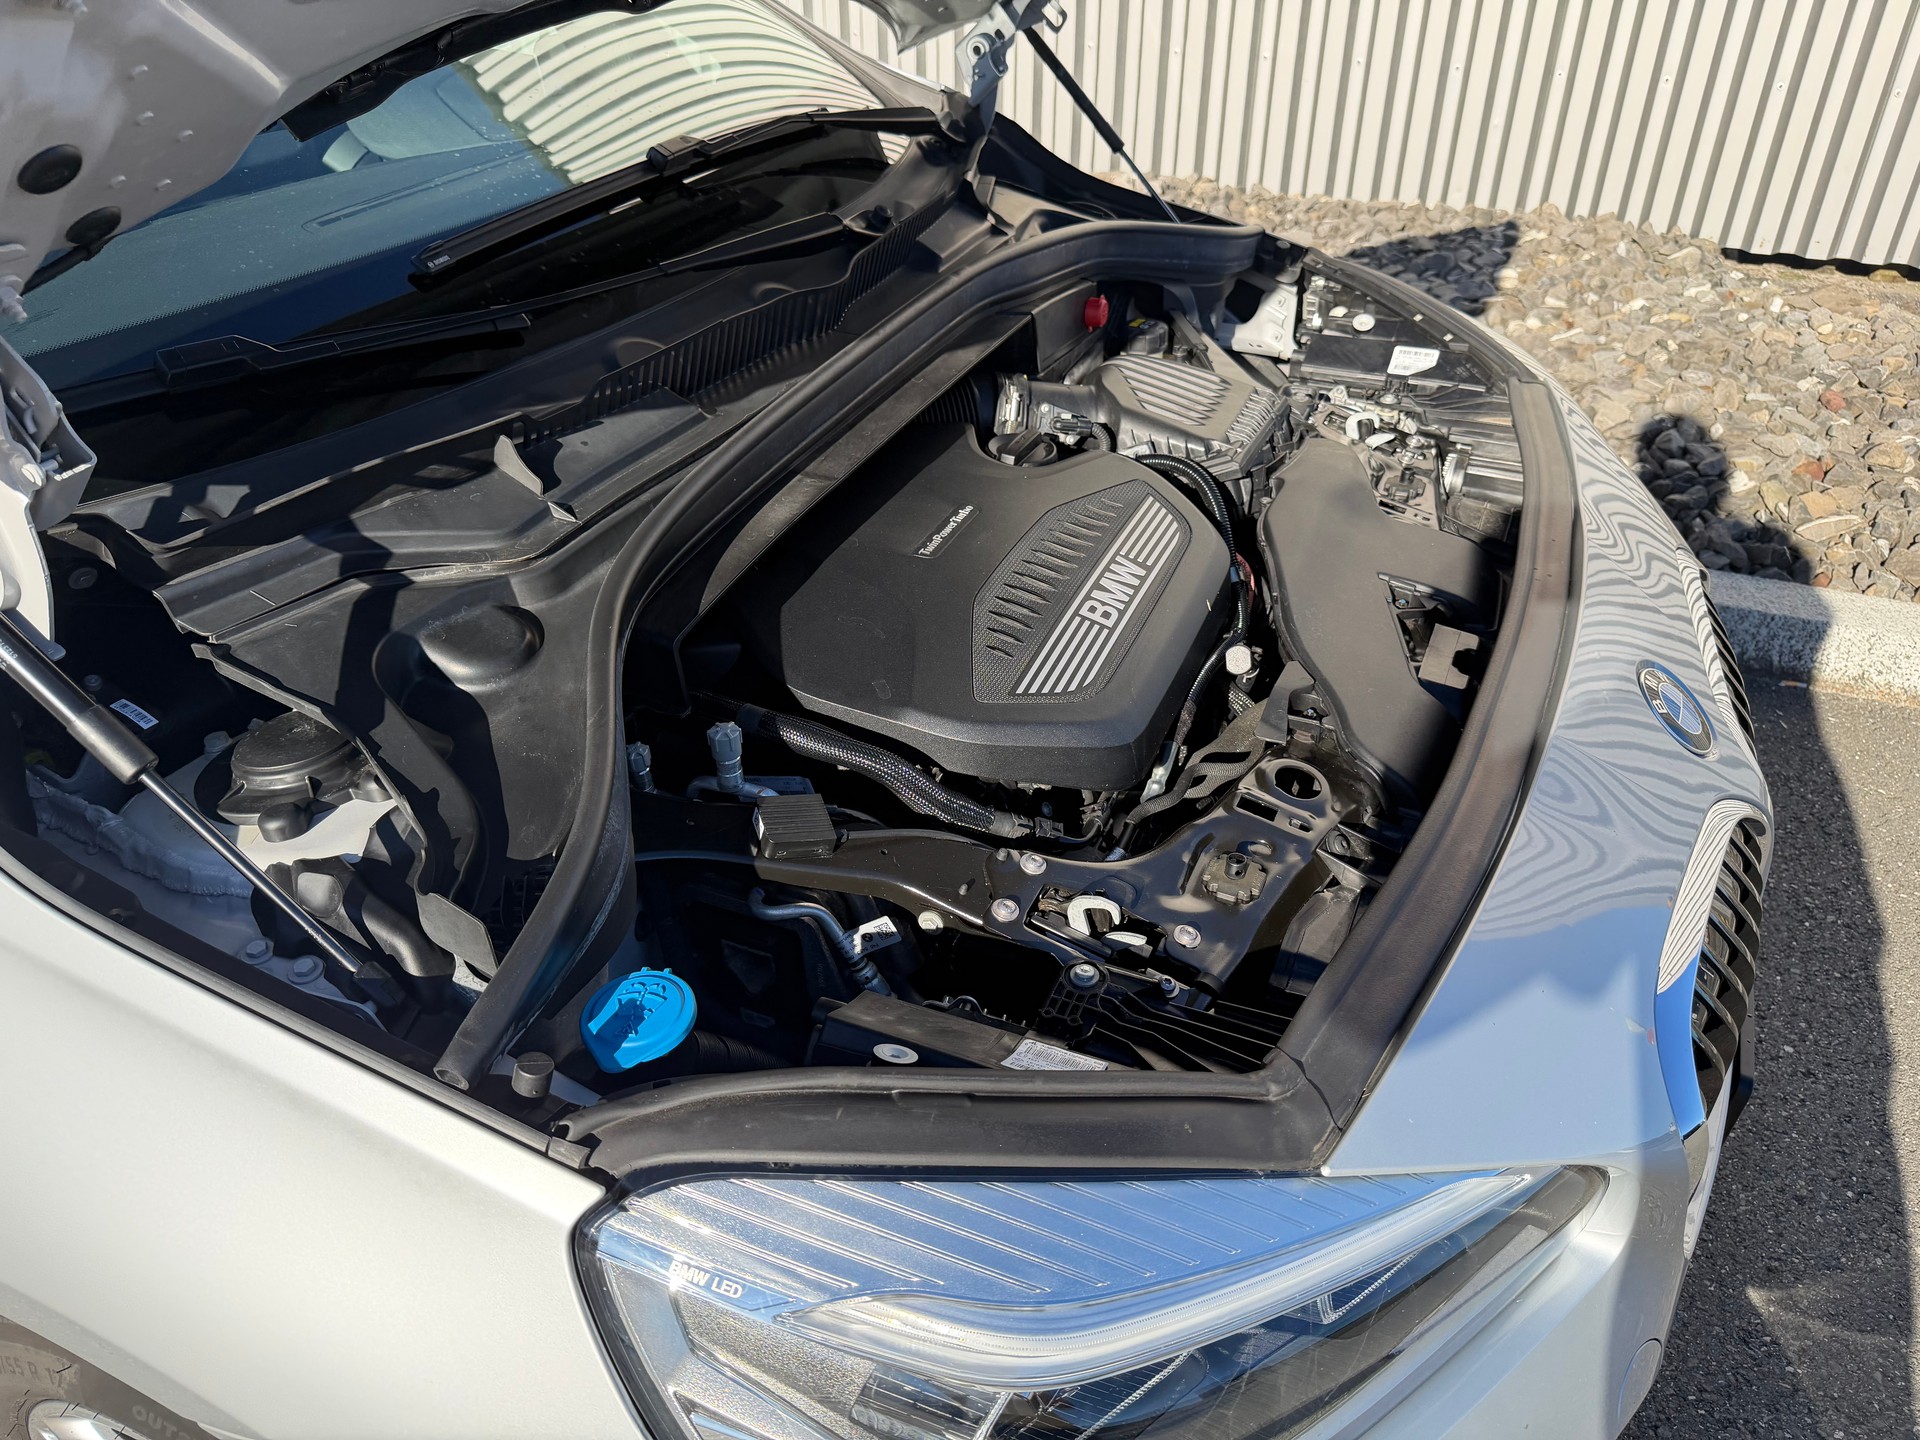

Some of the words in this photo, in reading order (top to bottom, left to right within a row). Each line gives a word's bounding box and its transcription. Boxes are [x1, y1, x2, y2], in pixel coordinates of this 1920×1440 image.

[918, 505, 974, 555] TwinPowerTurbo
[1078, 555, 1147, 628] BMW
[668, 1260, 710, 1286] BMW
[711, 1277, 743, 1299] LED
